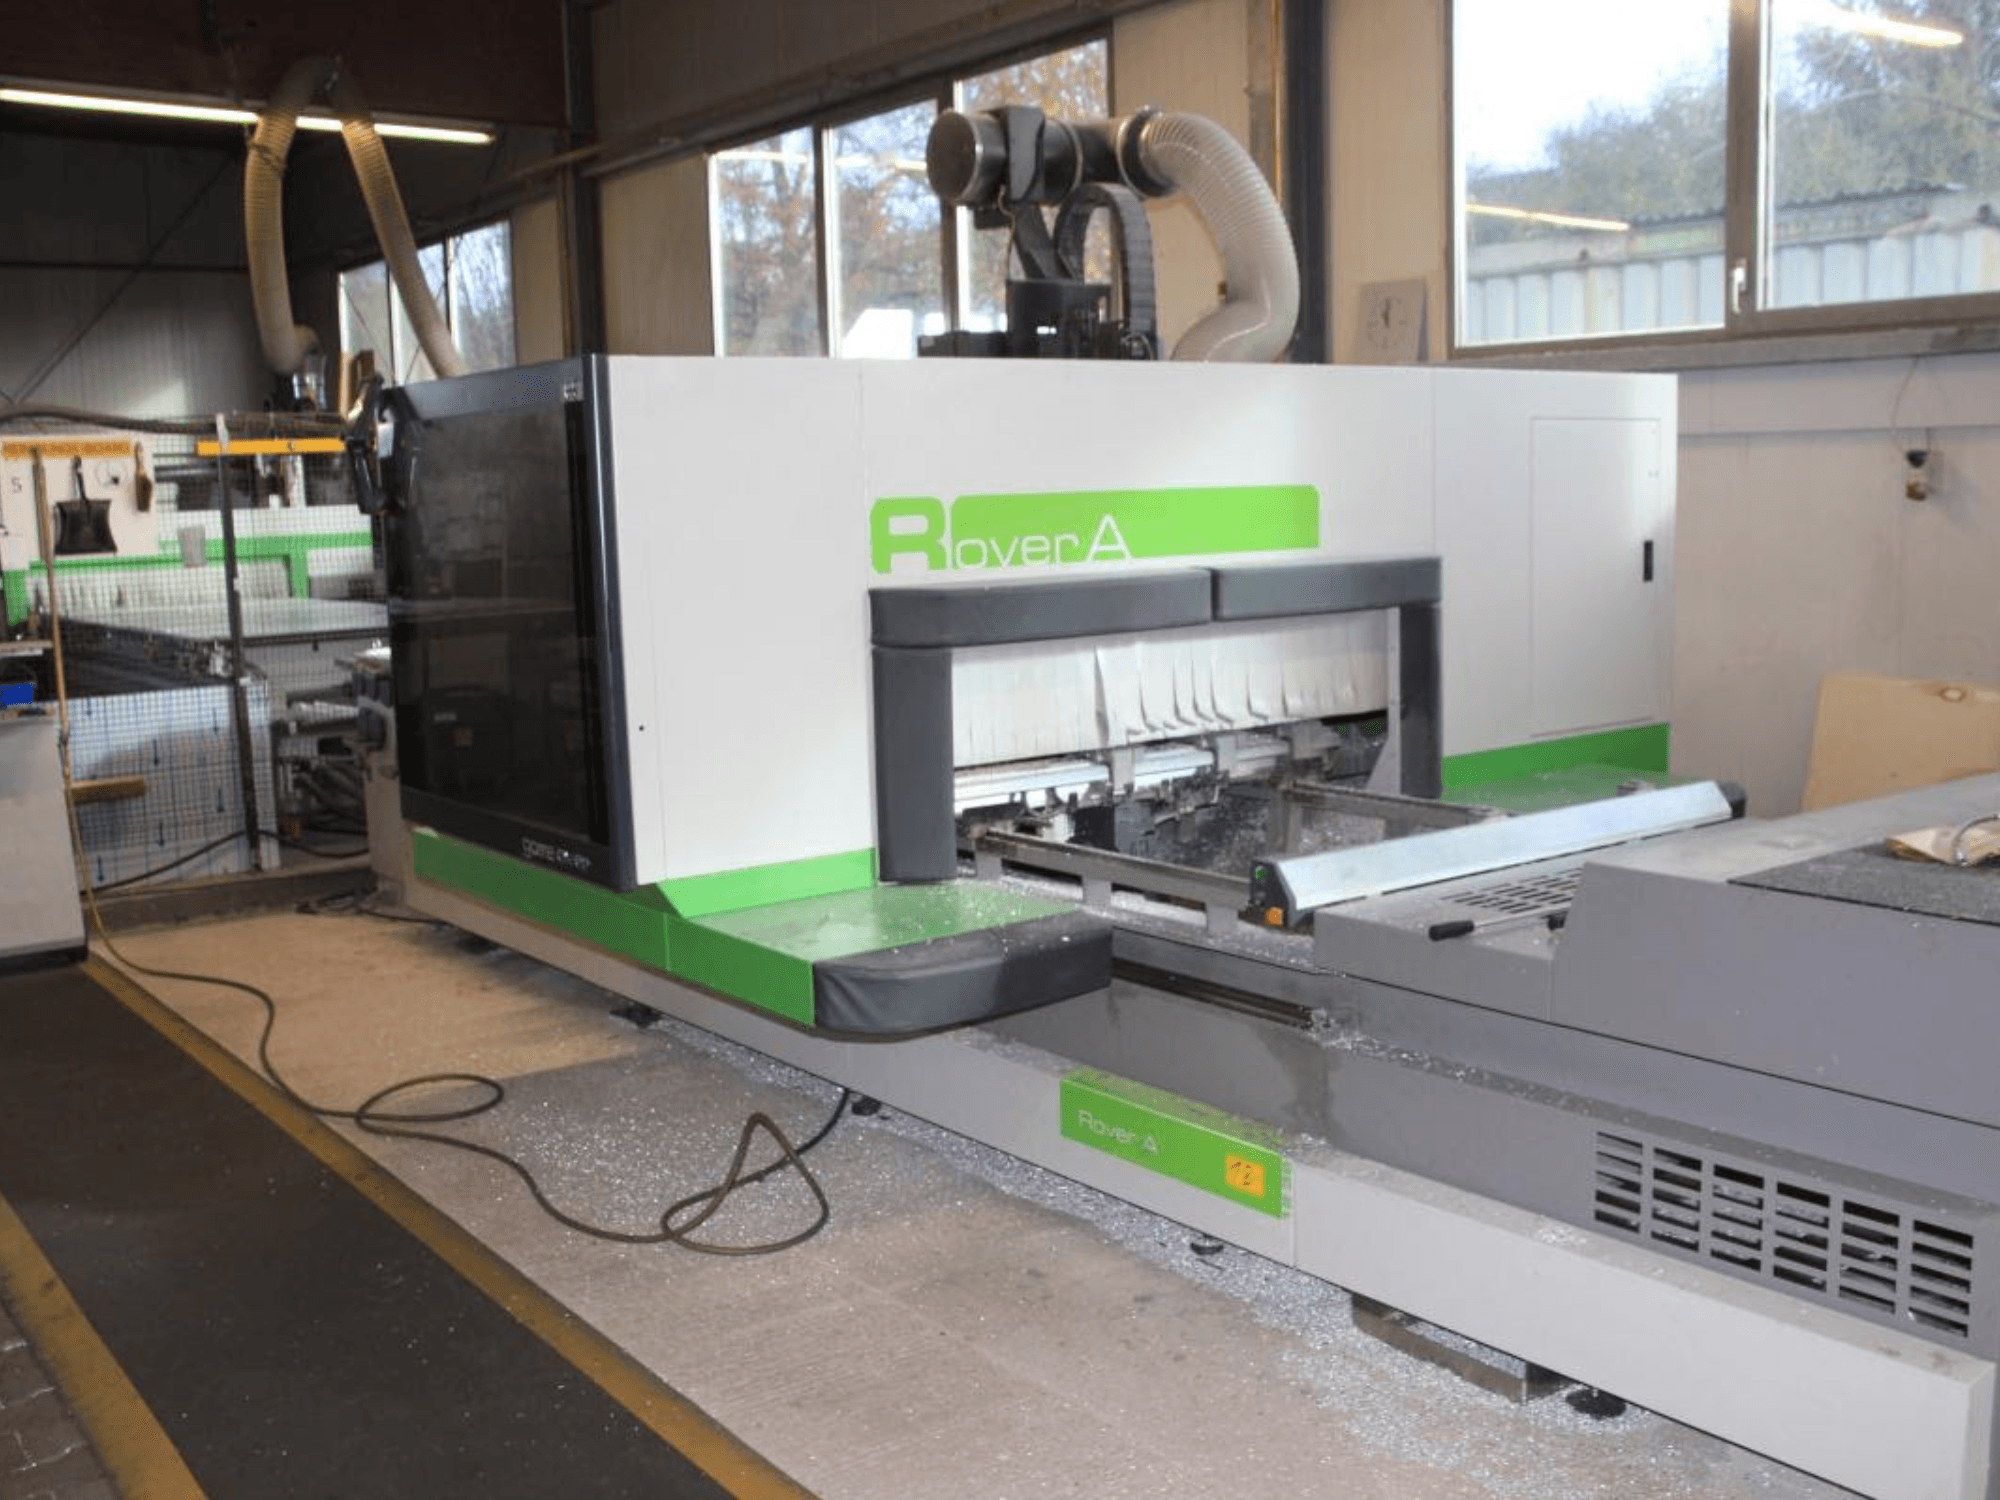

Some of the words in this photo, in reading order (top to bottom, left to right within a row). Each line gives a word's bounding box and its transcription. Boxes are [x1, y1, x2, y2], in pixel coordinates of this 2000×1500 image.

[871, 495, 1080, 573] Rover
[1087, 513, 1132, 561] A
[1078, 1109, 1137, 1145] Rover
